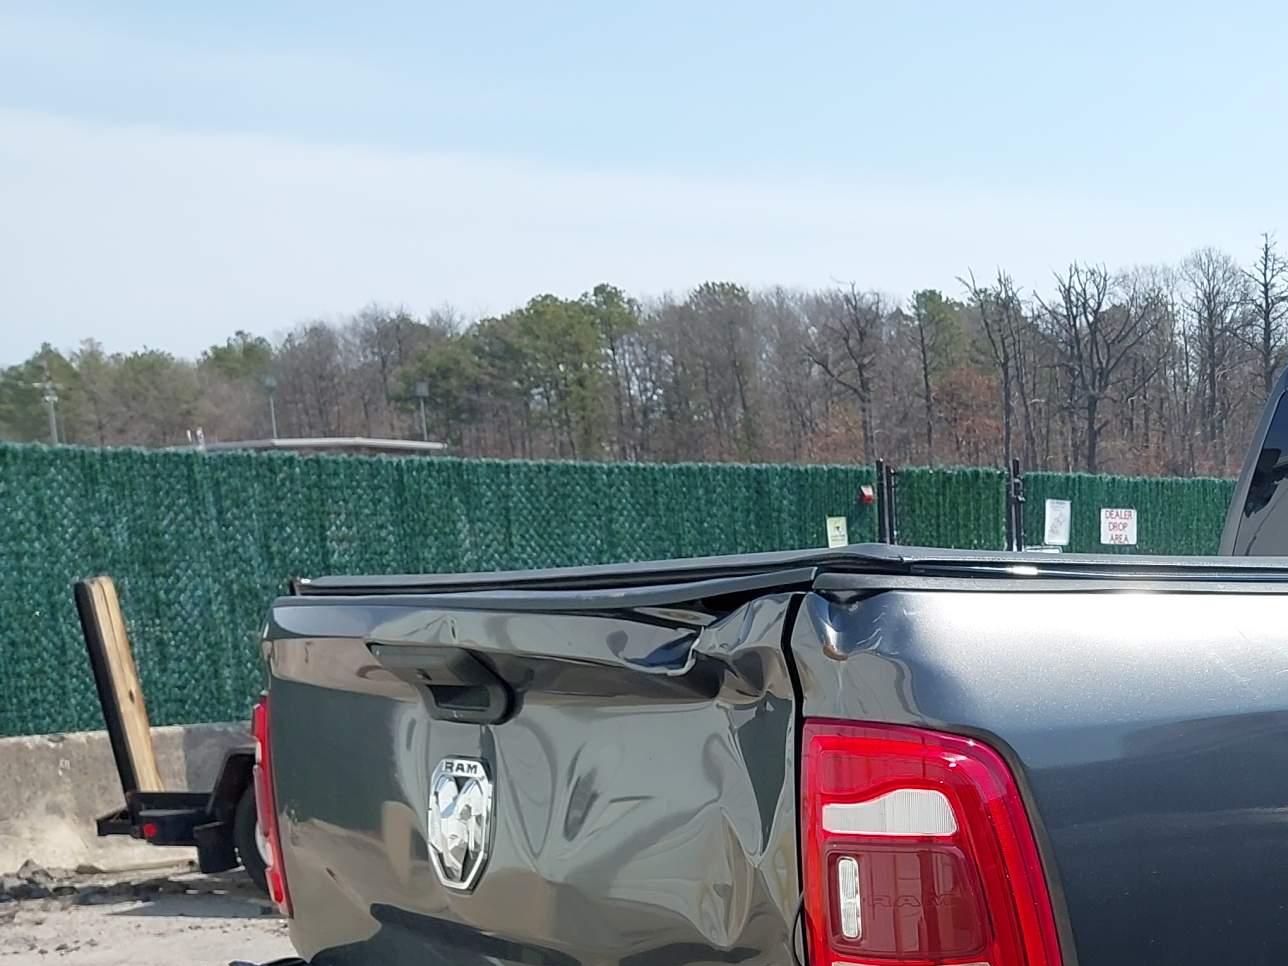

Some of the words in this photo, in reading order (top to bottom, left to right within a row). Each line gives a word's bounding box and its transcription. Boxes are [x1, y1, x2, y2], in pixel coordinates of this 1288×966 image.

[1105, 510, 1133, 520] DEALER
[1108, 521, 1129, 531] DROP
[1109, 534, 1130, 544] AREA
[444, 761, 478, 775] RAM
[865, 893, 957, 908] RAM
